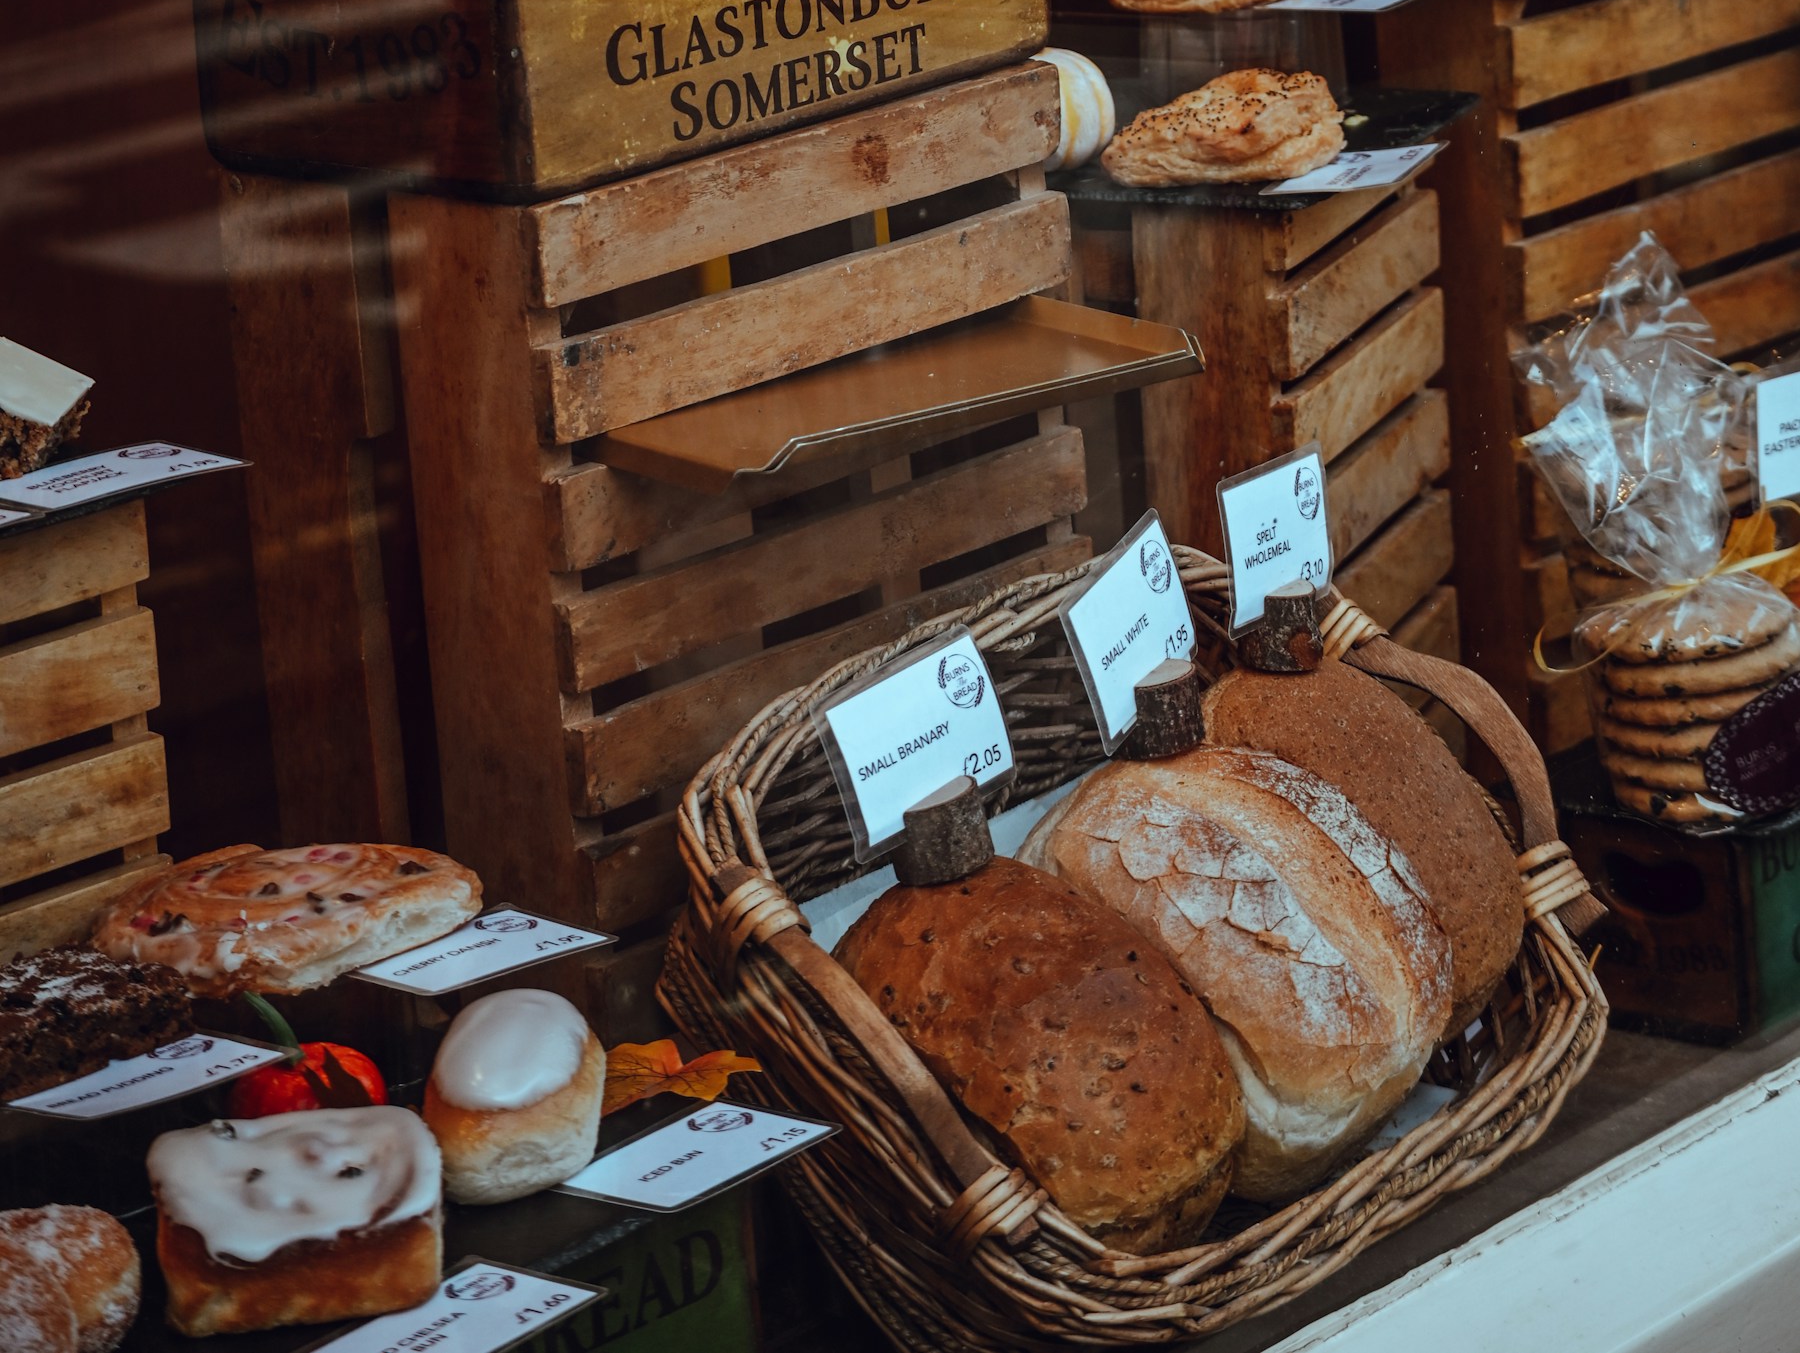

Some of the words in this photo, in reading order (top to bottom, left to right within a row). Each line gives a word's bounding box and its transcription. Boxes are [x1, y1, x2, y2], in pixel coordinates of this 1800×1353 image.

[669, 22, 927, 142] SOMERSET
[25, 464, 107, 490] BLUEBERRY
[41, 468, 115, 491] YOGHURT
[54, 471, 129, 494] FLAPJACK
[1299, 477, 1314, 492] BURNS
[1301, 496, 1316, 511] BREAD
[1256, 525, 1277, 546] SPELT
[1144, 548, 1161, 569] BURNS
[1244, 539, 1292, 570] WHOLEMEAL
[1151, 566, 1167, 587] BREAD
[1300, 558, 1324, 581] £3.10
[1101, 640, 1127, 671] SMALL
[1124, 613, 1150, 645] WHITE
[1165, 624, 1188, 660] £1.95
[944, 662, 971, 682] BURNS
[952, 681, 978, 701] BREAD
[858, 752, 898, 782] SMALL
[897, 720, 950, 761] BRANARY
[963, 743, 1002, 776] £2.05
[535, 934, 584, 952] £1.95
[392, 954, 447, 977] CHERRY
[448, 937, 503, 958] DANISH
[205, 1054, 259, 1078] £1.75
[46, 1090, 102, 1109] BREAD
[101, 1065, 175, 1094] PUDDING
[759, 1126, 808, 1152] £1.15
[637, 1165, 674, 1183] ICED
[669, 1149, 704, 1167] BUN
[514, 1293, 571, 1325] £1.60
[396, 1312, 468, 1347] CHELSEA
[410, 1333, 449, 1352] BUN
